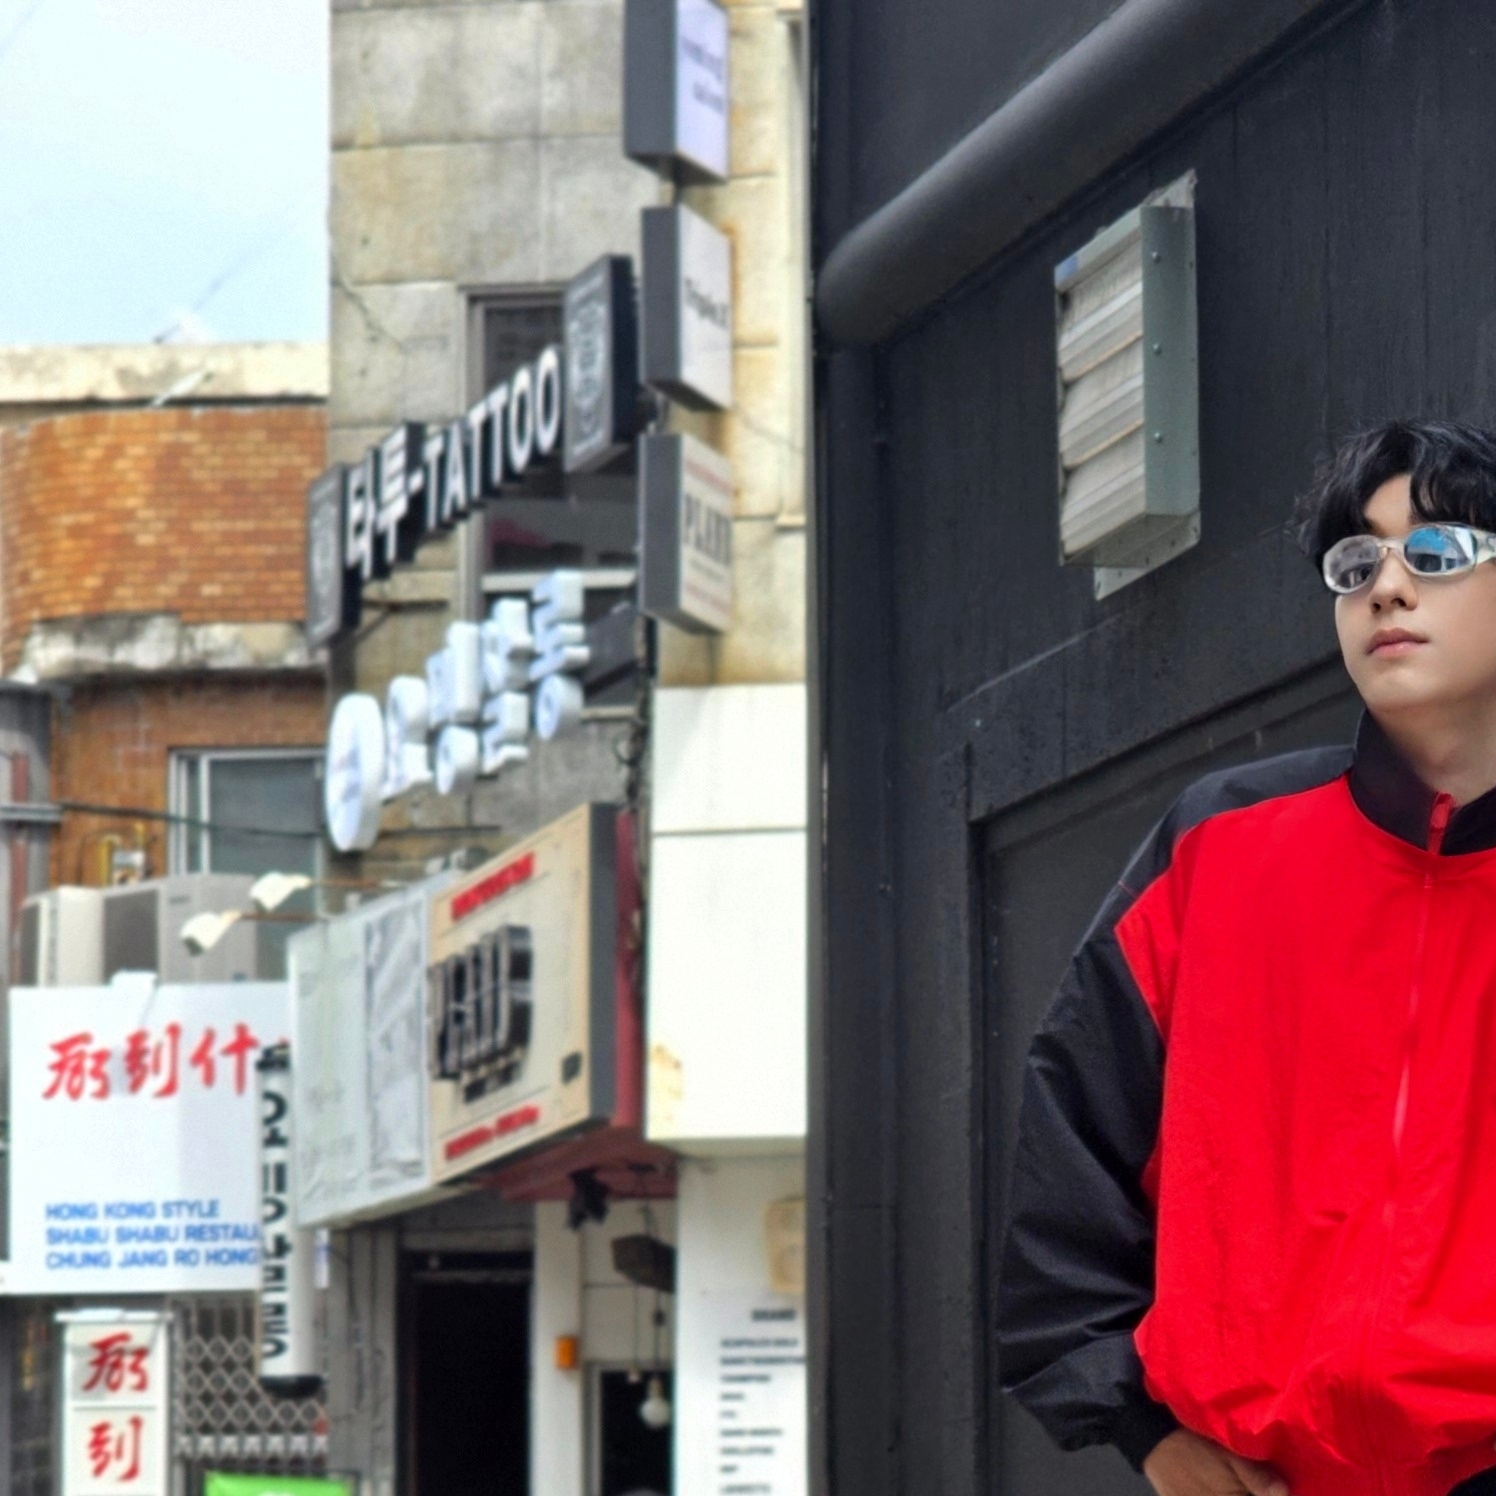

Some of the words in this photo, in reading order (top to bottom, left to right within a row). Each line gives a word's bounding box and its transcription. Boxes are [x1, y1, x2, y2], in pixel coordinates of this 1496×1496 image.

[46, 1203, 98, 1220] HONG
[104, 1202, 155, 1219] KONG
[162, 1200, 219, 1218] STYLE
[46, 1227, 108, 1244] SHABU
[116, 1225, 179, 1242] SHABU
[46, 1251, 110, 1268] CHUNG
[118, 1250, 168, 1267] JANG
[175, 1249, 199, 1266] RO
